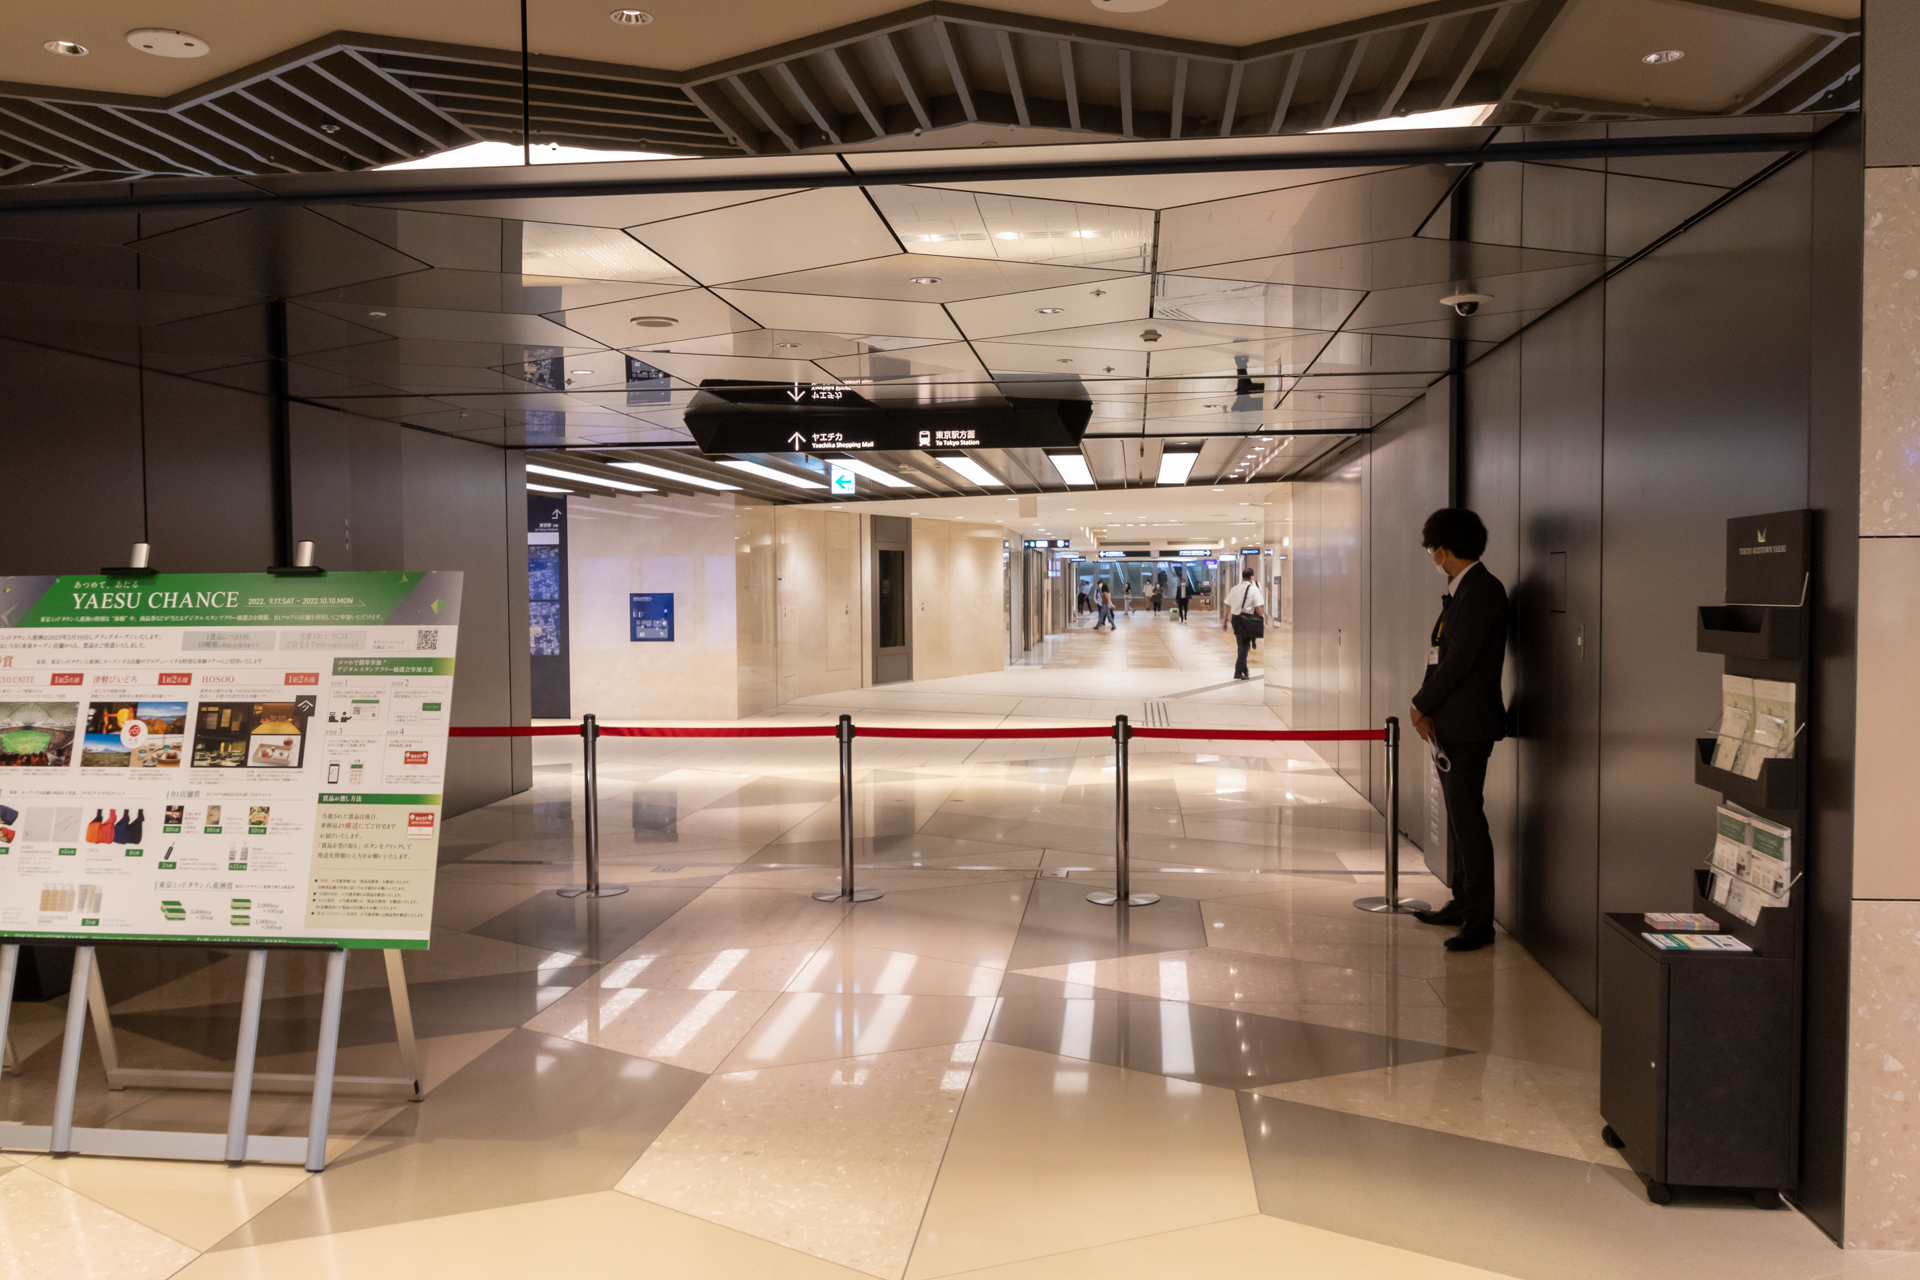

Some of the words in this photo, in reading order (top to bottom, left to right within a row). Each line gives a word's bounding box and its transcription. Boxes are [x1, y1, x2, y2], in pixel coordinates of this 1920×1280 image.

[811, 432, 843, 442] ヤエチカ
[935, 430, 976, 440] 東京駅方面
[72, 592, 143, 609] YAESU
[148, 591, 239, 609] CHANCE
[92, 675, 138, 684] 津軽びいどろ
[201, 675, 235, 683] HOSOO
[338, 727, 343, 735] 3
[170, 790, 201, 798] B1店舗賞
[322, 795, 362, 803] 賞品お渡し方法
[159, 881, 233, 890] 東京ミッドタウン八重洲賞
